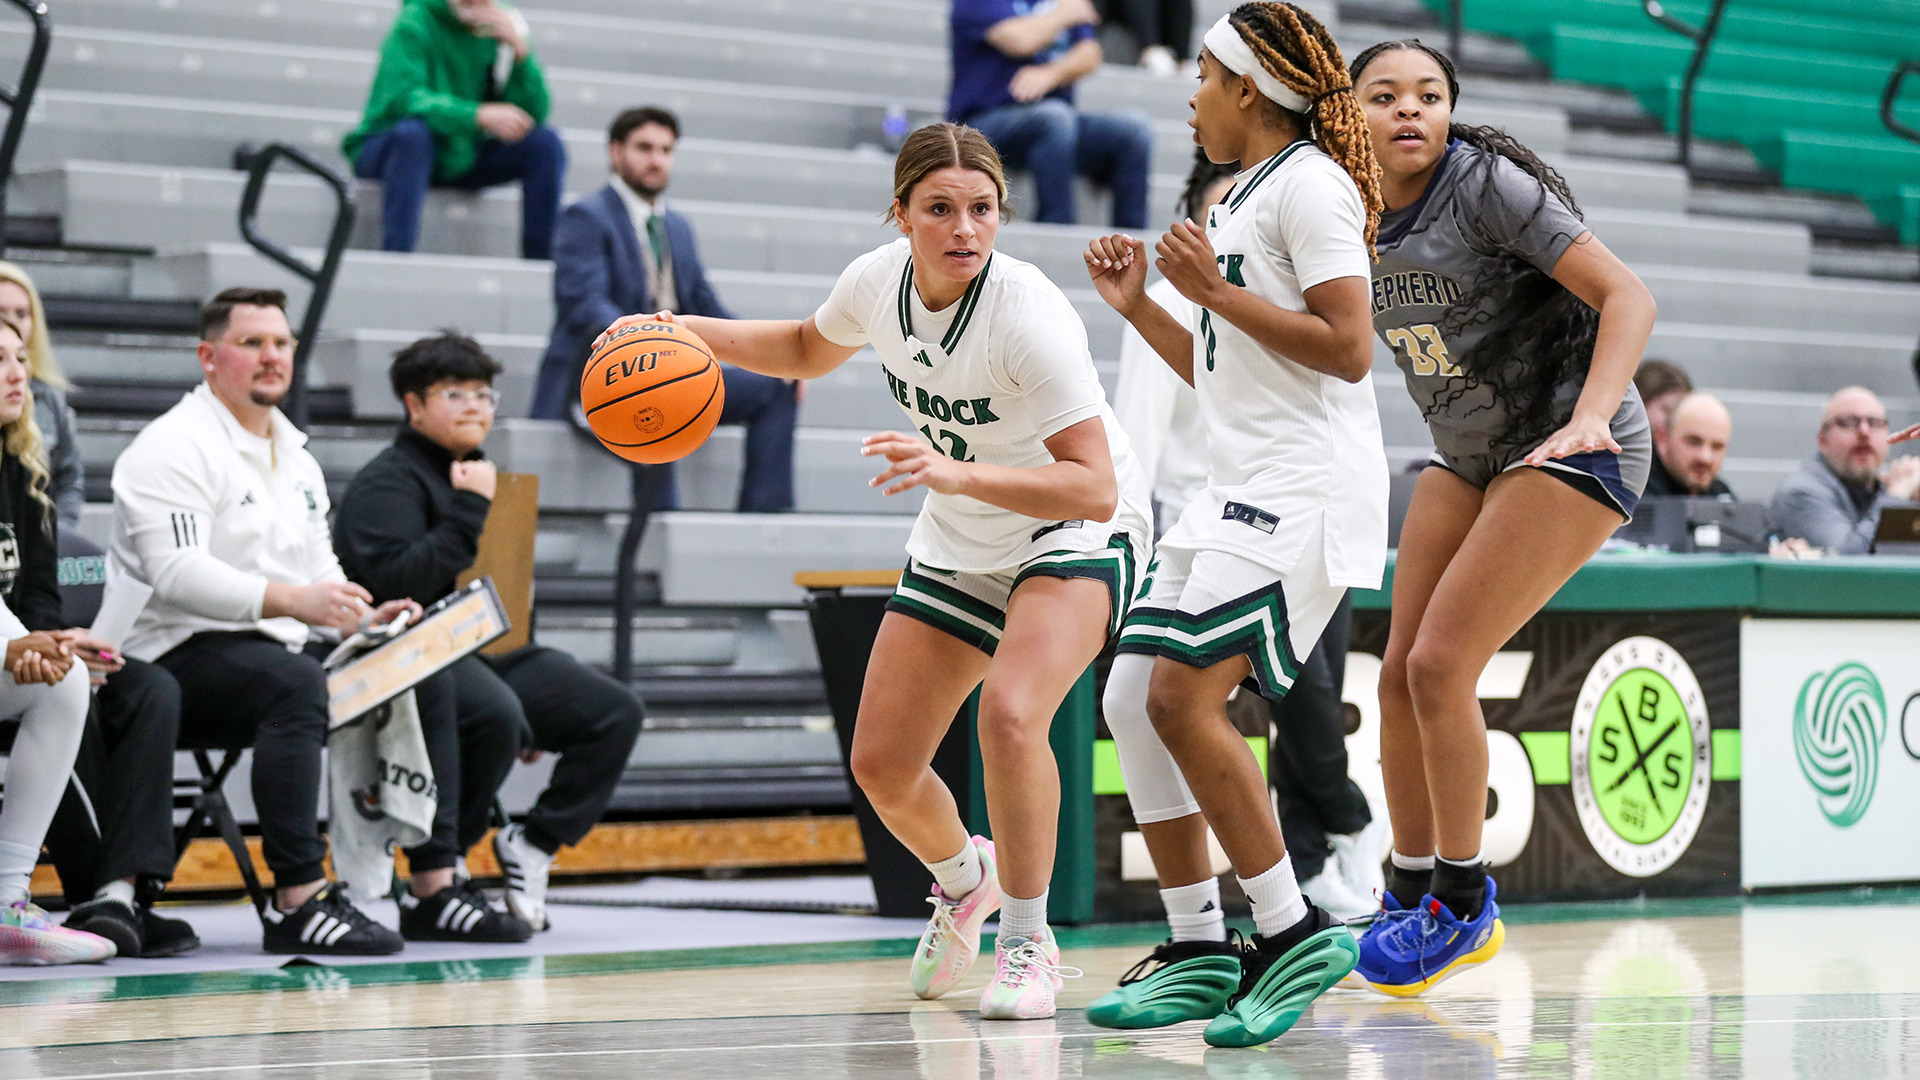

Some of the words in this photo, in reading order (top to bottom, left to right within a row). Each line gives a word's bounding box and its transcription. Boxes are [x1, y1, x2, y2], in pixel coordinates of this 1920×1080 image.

[915, 386, 1001, 426] ROCK
[1639, 685, 1660, 722] B
[1599, 727, 1620, 763] S
[1661, 754, 1682, 789] S
